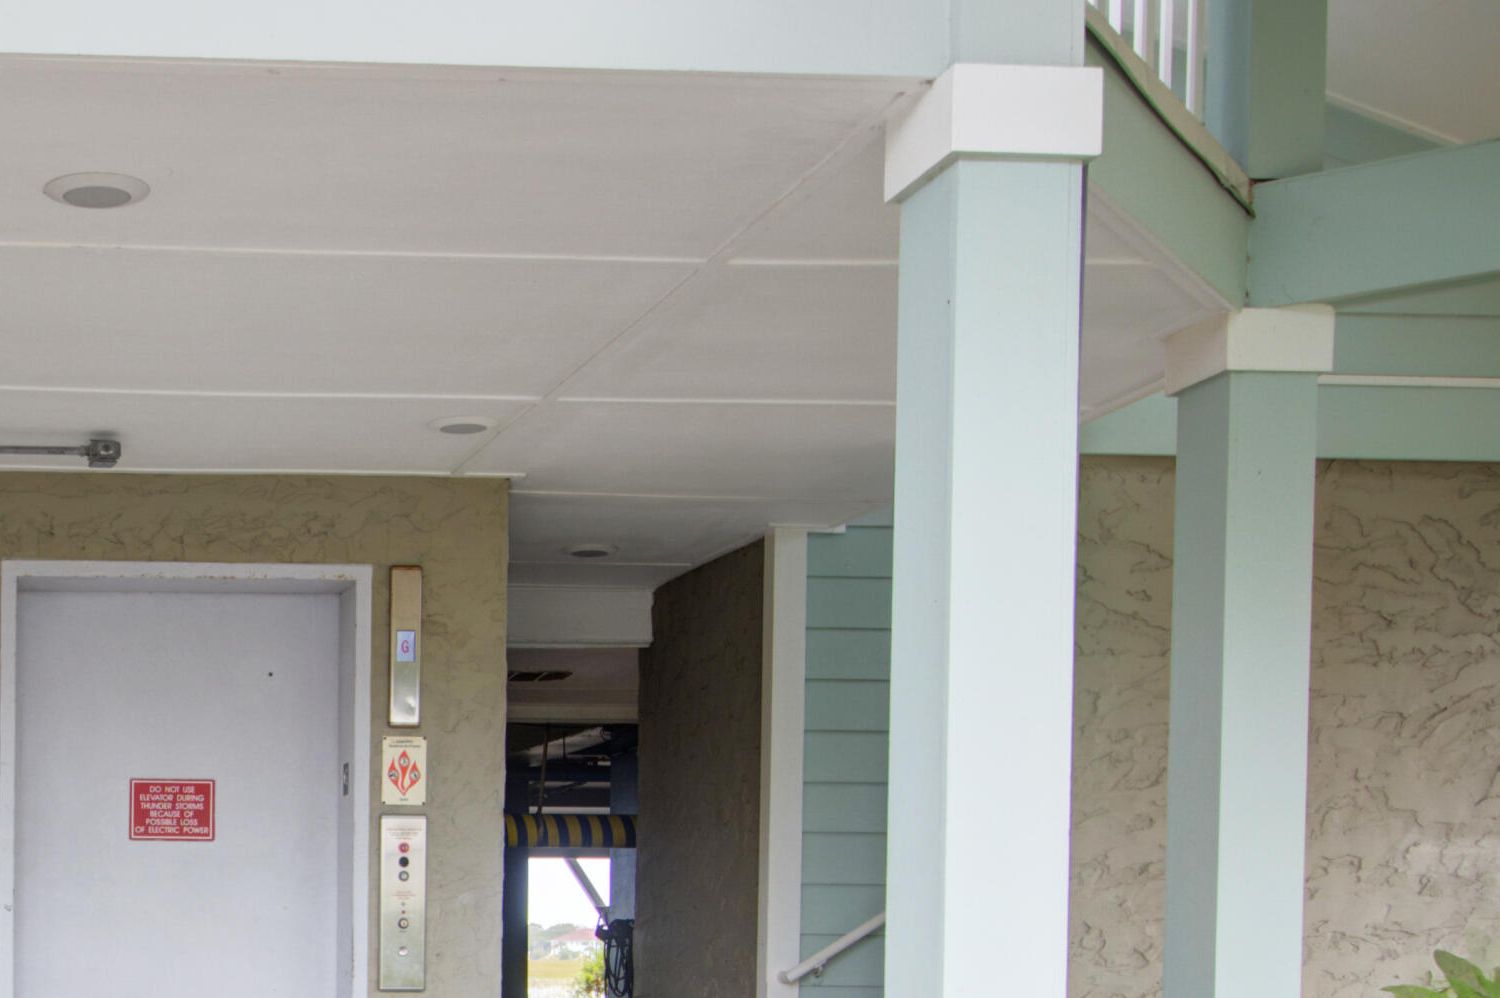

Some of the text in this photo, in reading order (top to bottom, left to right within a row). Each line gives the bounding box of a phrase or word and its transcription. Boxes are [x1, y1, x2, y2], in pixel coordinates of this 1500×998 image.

[401, 639, 410, 653] G
[149, 785, 195, 793] DO NOT USE
[139, 793, 205, 802] ELEVATOR DURING
[140, 802, 204, 810] THUNDER STORMS
[149, 810, 194, 818] BECAUSE OF
[146, 818, 177, 826] POSSIBLE
[135, 826, 209, 834] OF ELECTRIC POWER
